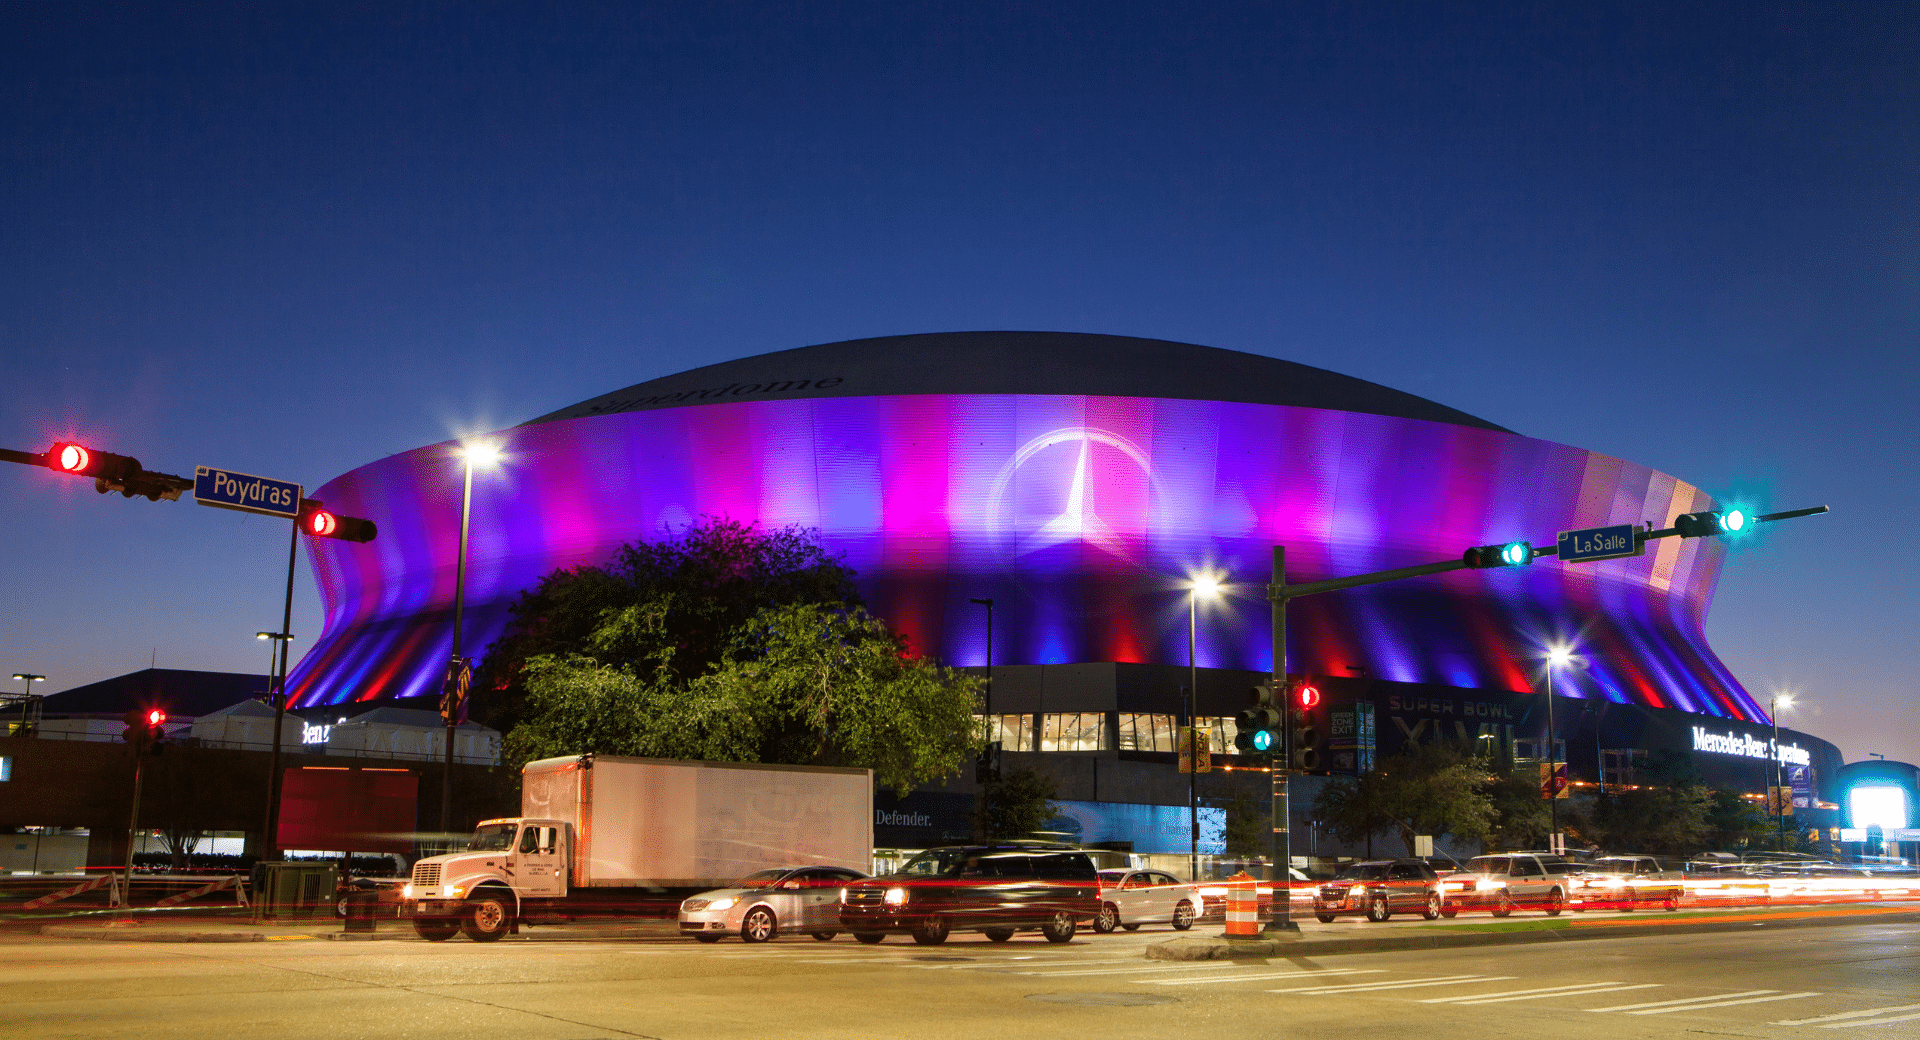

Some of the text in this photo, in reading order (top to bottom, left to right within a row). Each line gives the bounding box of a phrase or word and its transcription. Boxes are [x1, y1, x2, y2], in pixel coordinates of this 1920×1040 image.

[214, 471, 292, 506] Poydras
[1390, 696, 1513, 719] SUPER BOWL
[1332, 726, 1354, 734] EXIT
[1692, 726, 1768, 759] Mercedes-Benz
[876, 809, 932, 827] Defender.
